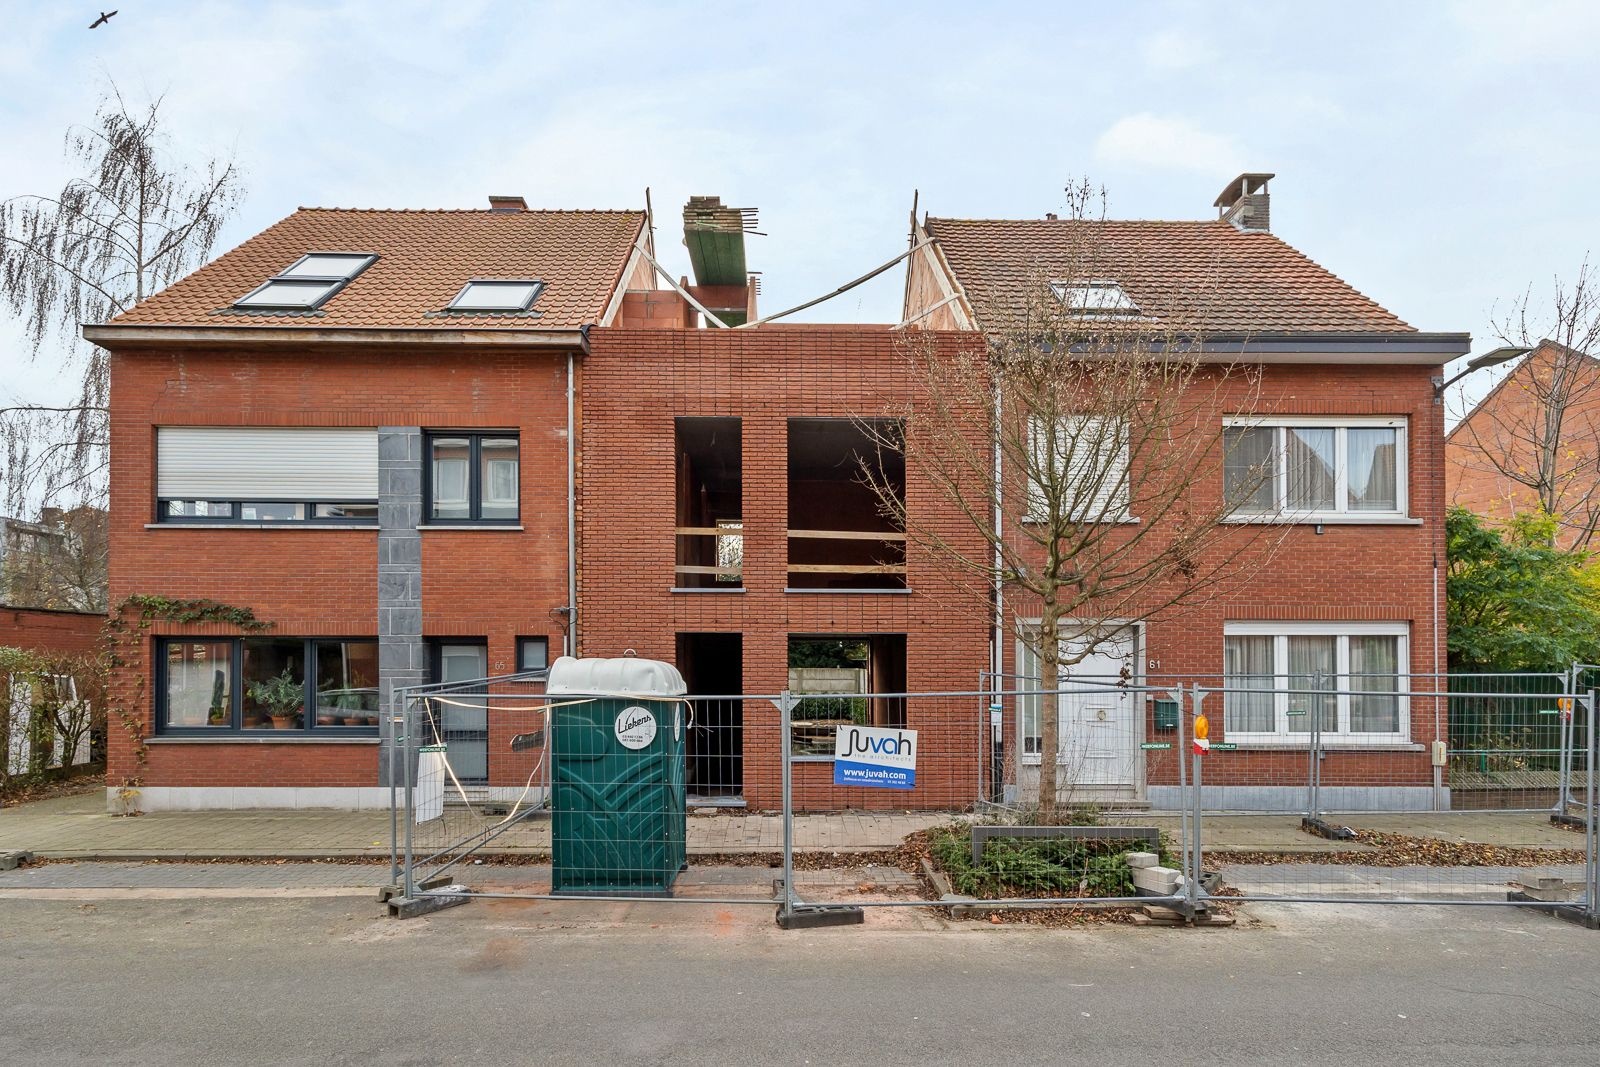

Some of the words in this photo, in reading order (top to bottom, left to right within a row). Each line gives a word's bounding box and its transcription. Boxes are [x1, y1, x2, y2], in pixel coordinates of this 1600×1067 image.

[494, 661, 505, 670] 65
[1149, 660, 1160, 669] 61
[618, 708, 652, 734] Liekens
[841, 729, 911, 757] Juvah
[843, 768, 906, 779] www.juvah.com
